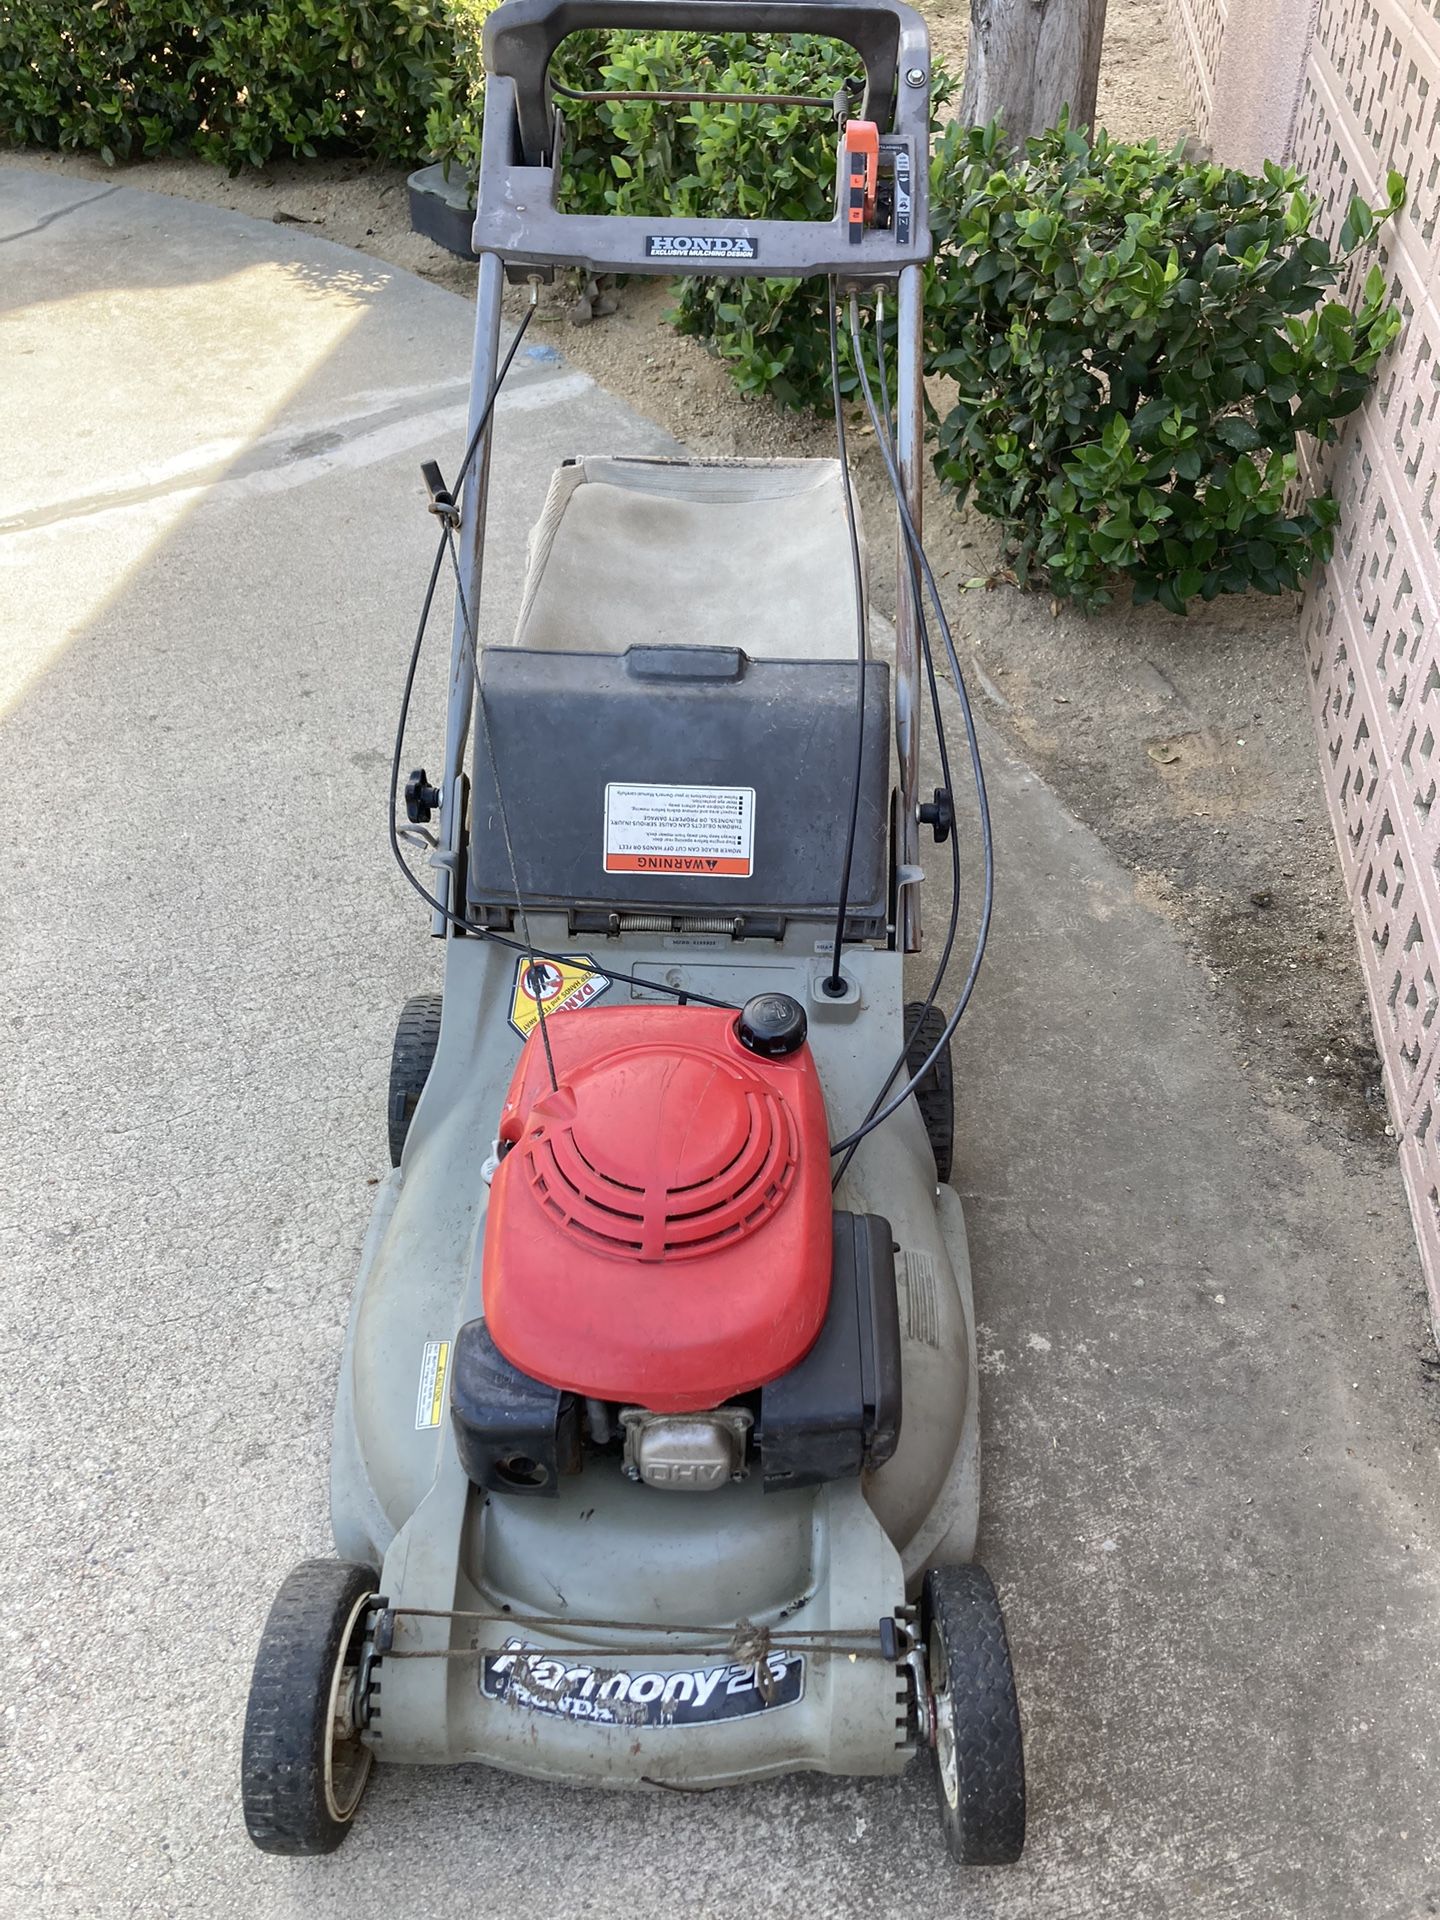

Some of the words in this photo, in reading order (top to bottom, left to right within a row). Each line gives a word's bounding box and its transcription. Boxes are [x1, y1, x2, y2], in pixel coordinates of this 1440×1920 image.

[651, 237, 754, 251] HONDA
[638, 857, 704, 869] WARNING
[561, 981, 581, 998] HANDS
[551, 997, 561, 1006] and
[523, 1016, 538, 1030] AWAY
[646, 1464, 722, 1480] OHV
